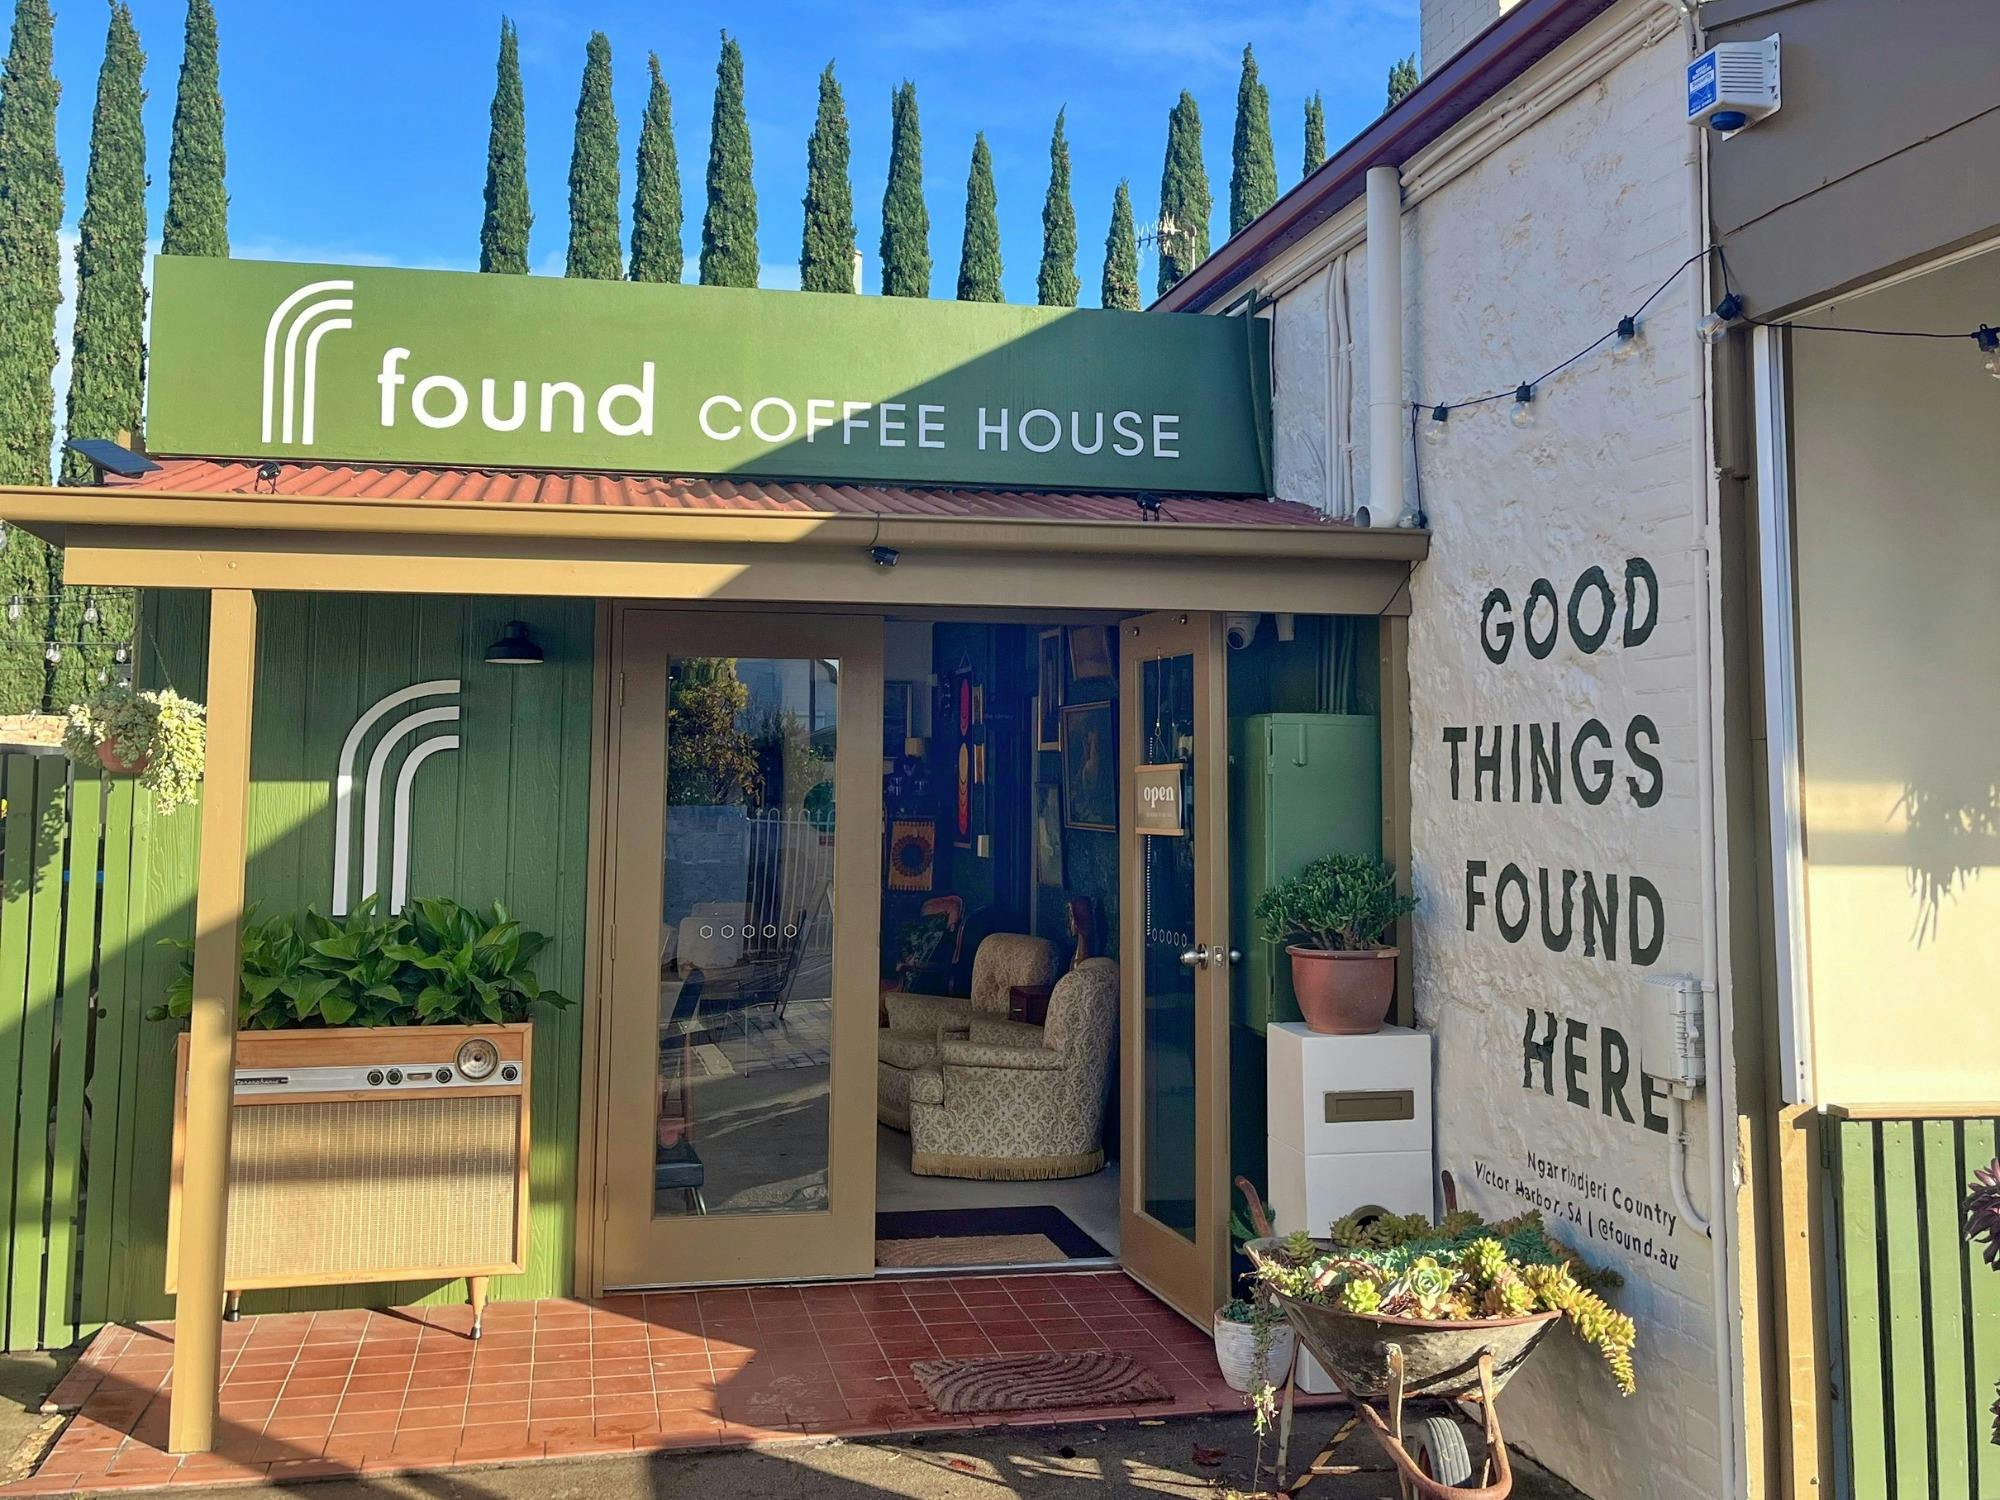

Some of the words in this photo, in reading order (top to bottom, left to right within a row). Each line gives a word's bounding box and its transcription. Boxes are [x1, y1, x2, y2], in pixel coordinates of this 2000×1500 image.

[378, 347, 655, 436] found
[698, 394, 946, 449] COFFEE
[978, 407, 1180, 458] HOUSE
[1480, 557, 1659, 664] GOOD
[1143, 786, 1175, 809] open
[1442, 714, 1664, 808] THINGS
[1465, 859, 1665, 967] FOUND
[1522, 1007, 1669, 1135] HERE
[1474, 1160, 1510, 1192] Victor
[1515, 1178, 1563, 1217] Harbor,
[1568, 1202, 1583, 1226] SA
[1598, 1218, 1679, 1270] @found.au
[1527, 1151, 1607, 1202] Ngarrindjeri
[1612, 1186, 1677, 1237] Country
